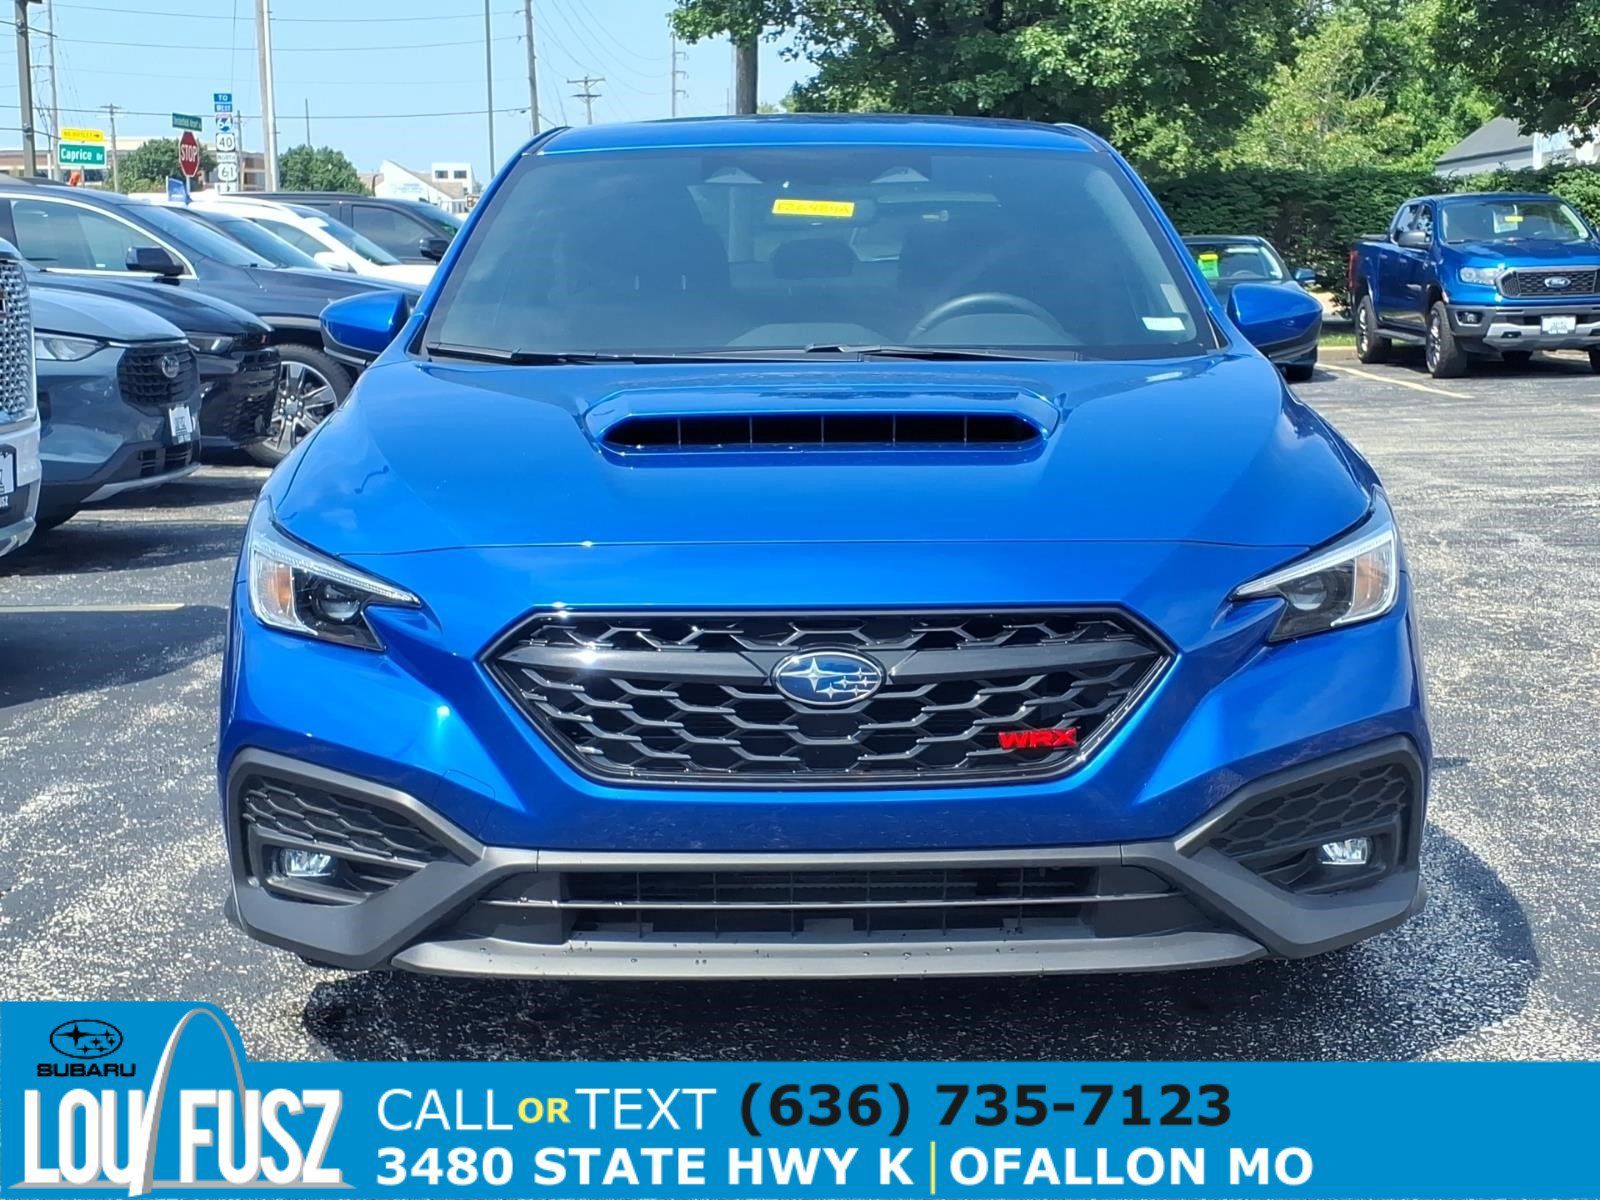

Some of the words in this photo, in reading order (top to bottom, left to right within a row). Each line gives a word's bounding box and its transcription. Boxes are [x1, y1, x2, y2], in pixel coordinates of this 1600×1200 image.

[219, 137, 233, 148] 40
[60, 148, 92, 162] Caprice
[181, 144, 198, 162] STOP
[221, 167, 234, 177] 61
[998, 728, 1077, 750] WRX
